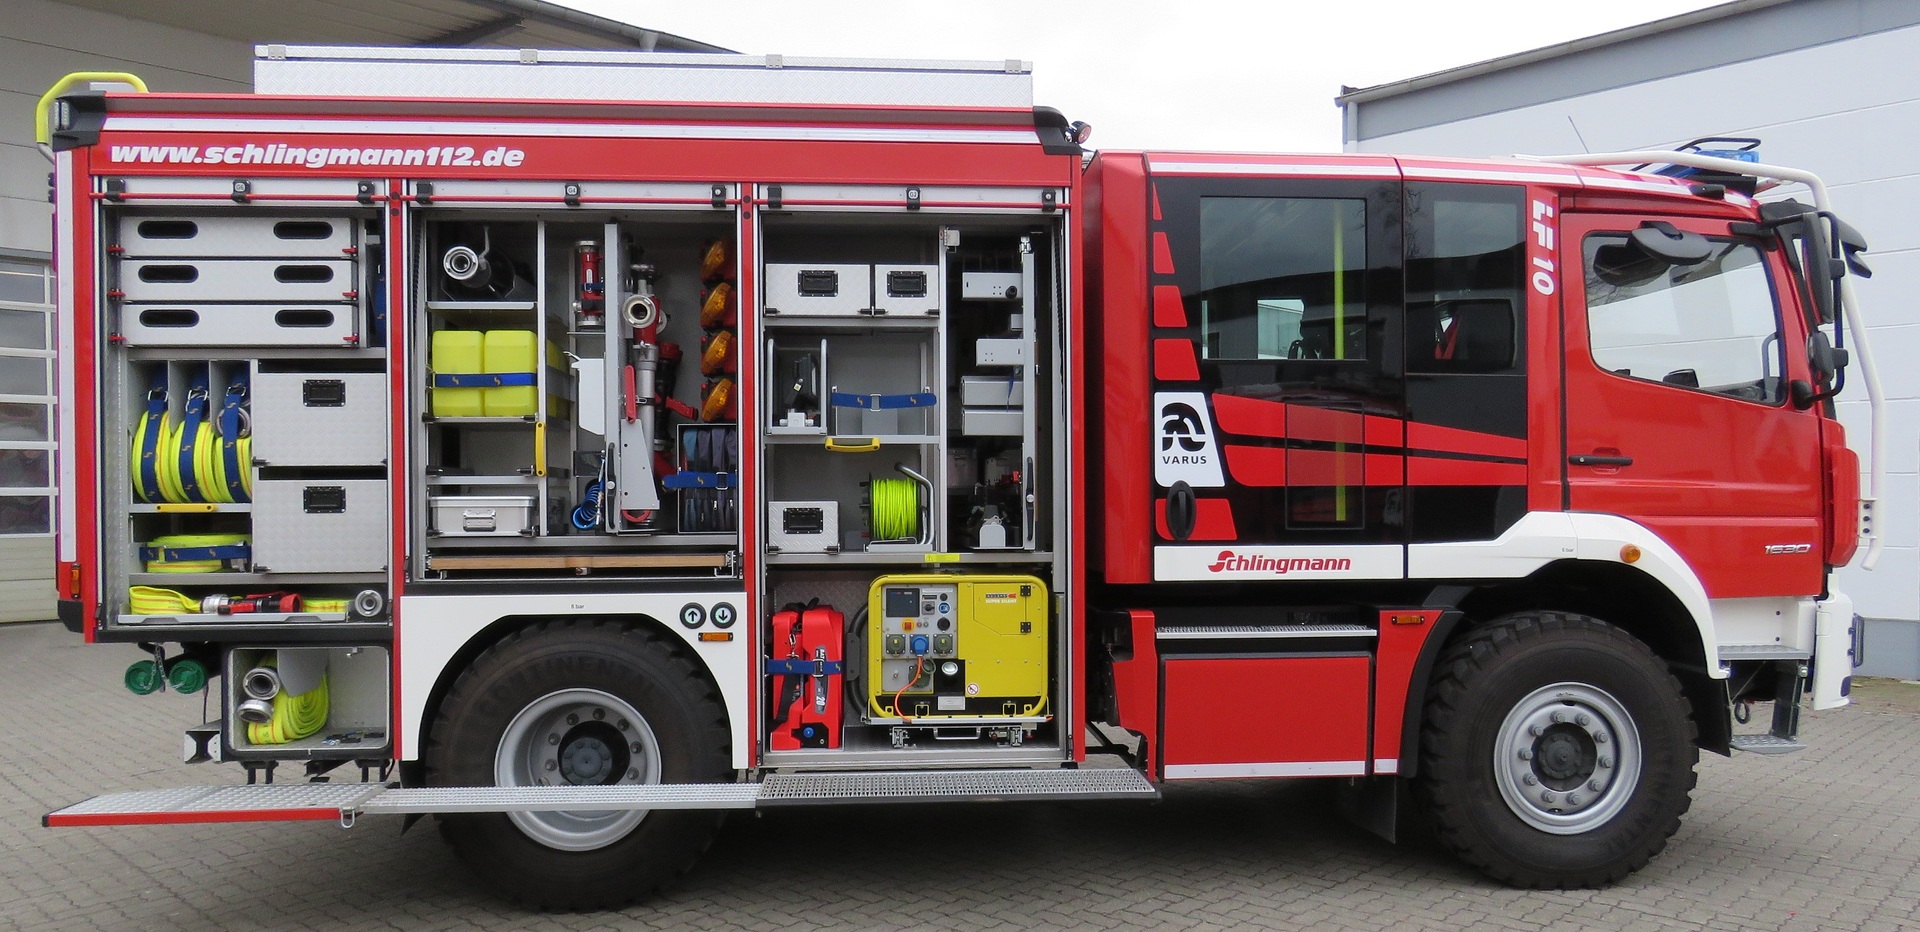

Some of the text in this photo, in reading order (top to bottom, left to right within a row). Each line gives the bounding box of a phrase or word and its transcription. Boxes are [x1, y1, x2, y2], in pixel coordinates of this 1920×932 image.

[111, 144, 525, 168] www.schlingmann112.de
[1532, 200, 1555, 296] LF 10
[1162, 456, 1207, 465] VARUS
[1765, 544, 1811, 554] 1630
[1208, 550, 1351, 574] Schlingmann
